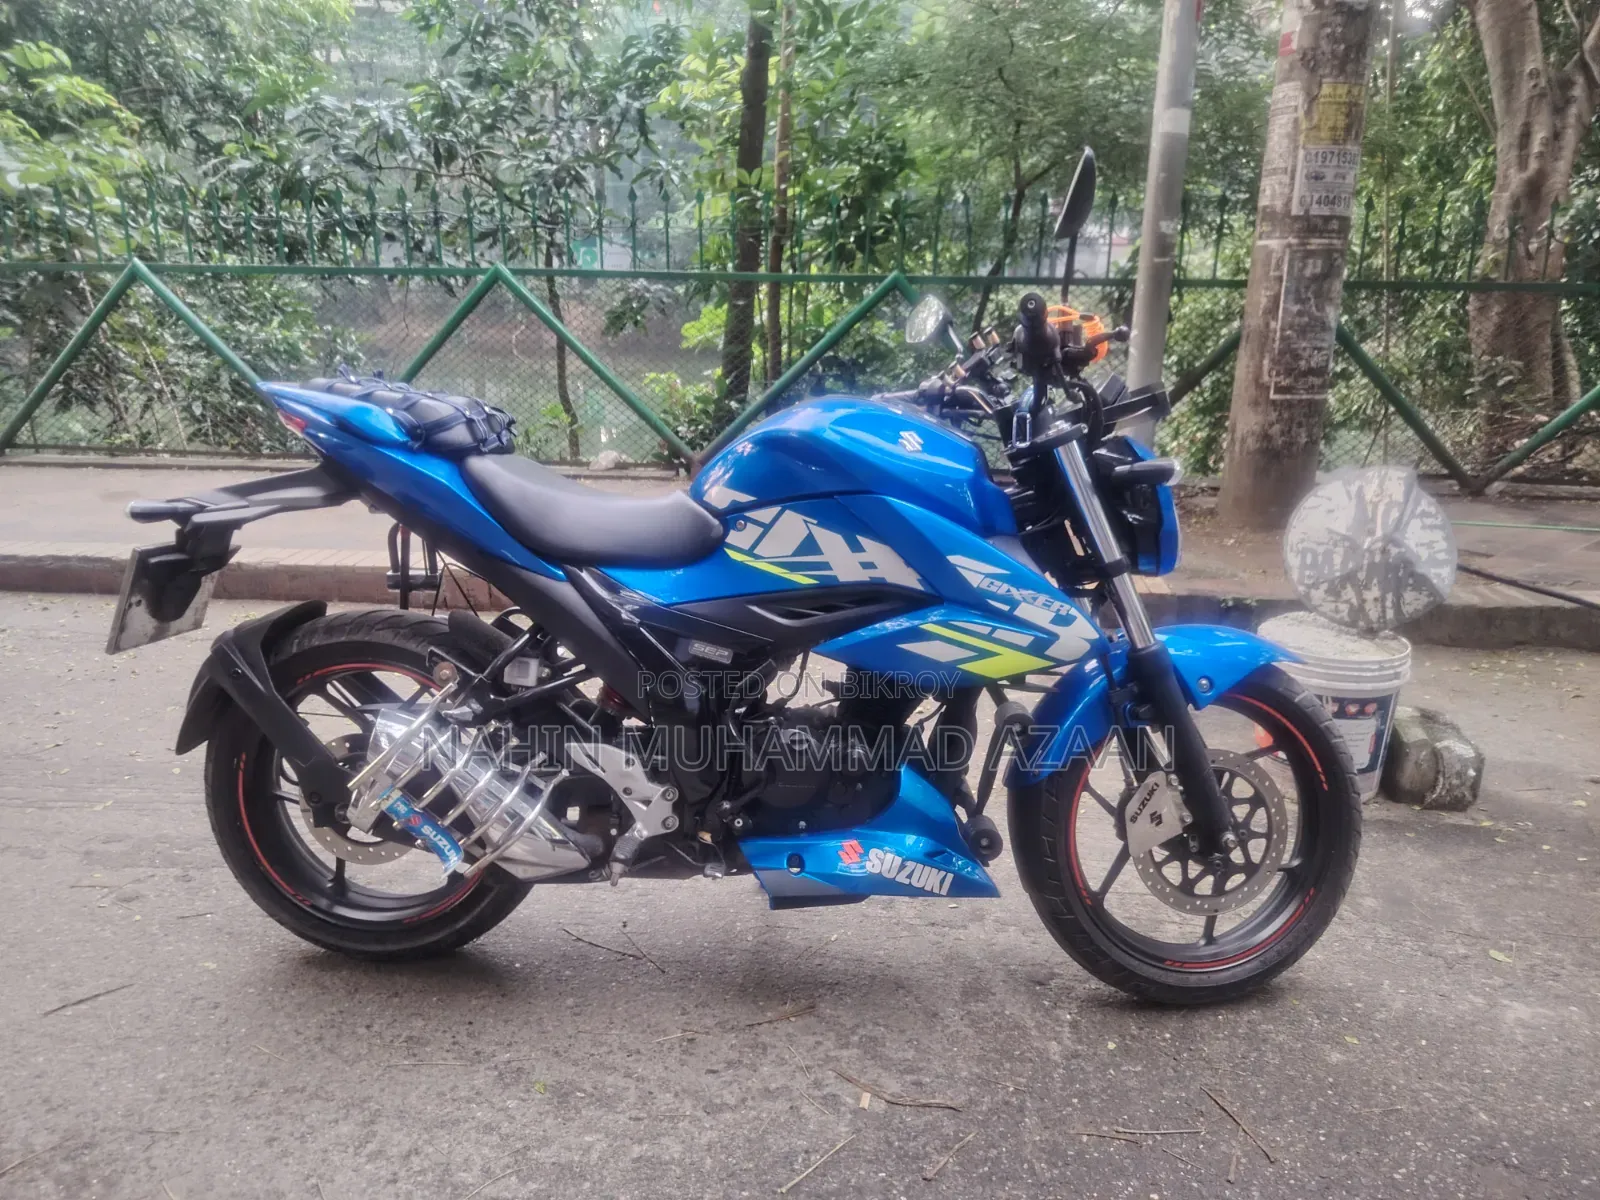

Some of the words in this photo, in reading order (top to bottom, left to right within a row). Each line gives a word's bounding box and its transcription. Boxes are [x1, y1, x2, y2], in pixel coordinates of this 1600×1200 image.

[979, 577, 1072, 615] GIXXER
[692, 643, 729, 656] SEP
[1130, 782, 1160, 824] SUZUKI
[866, 848, 954, 895] SUZUKI
